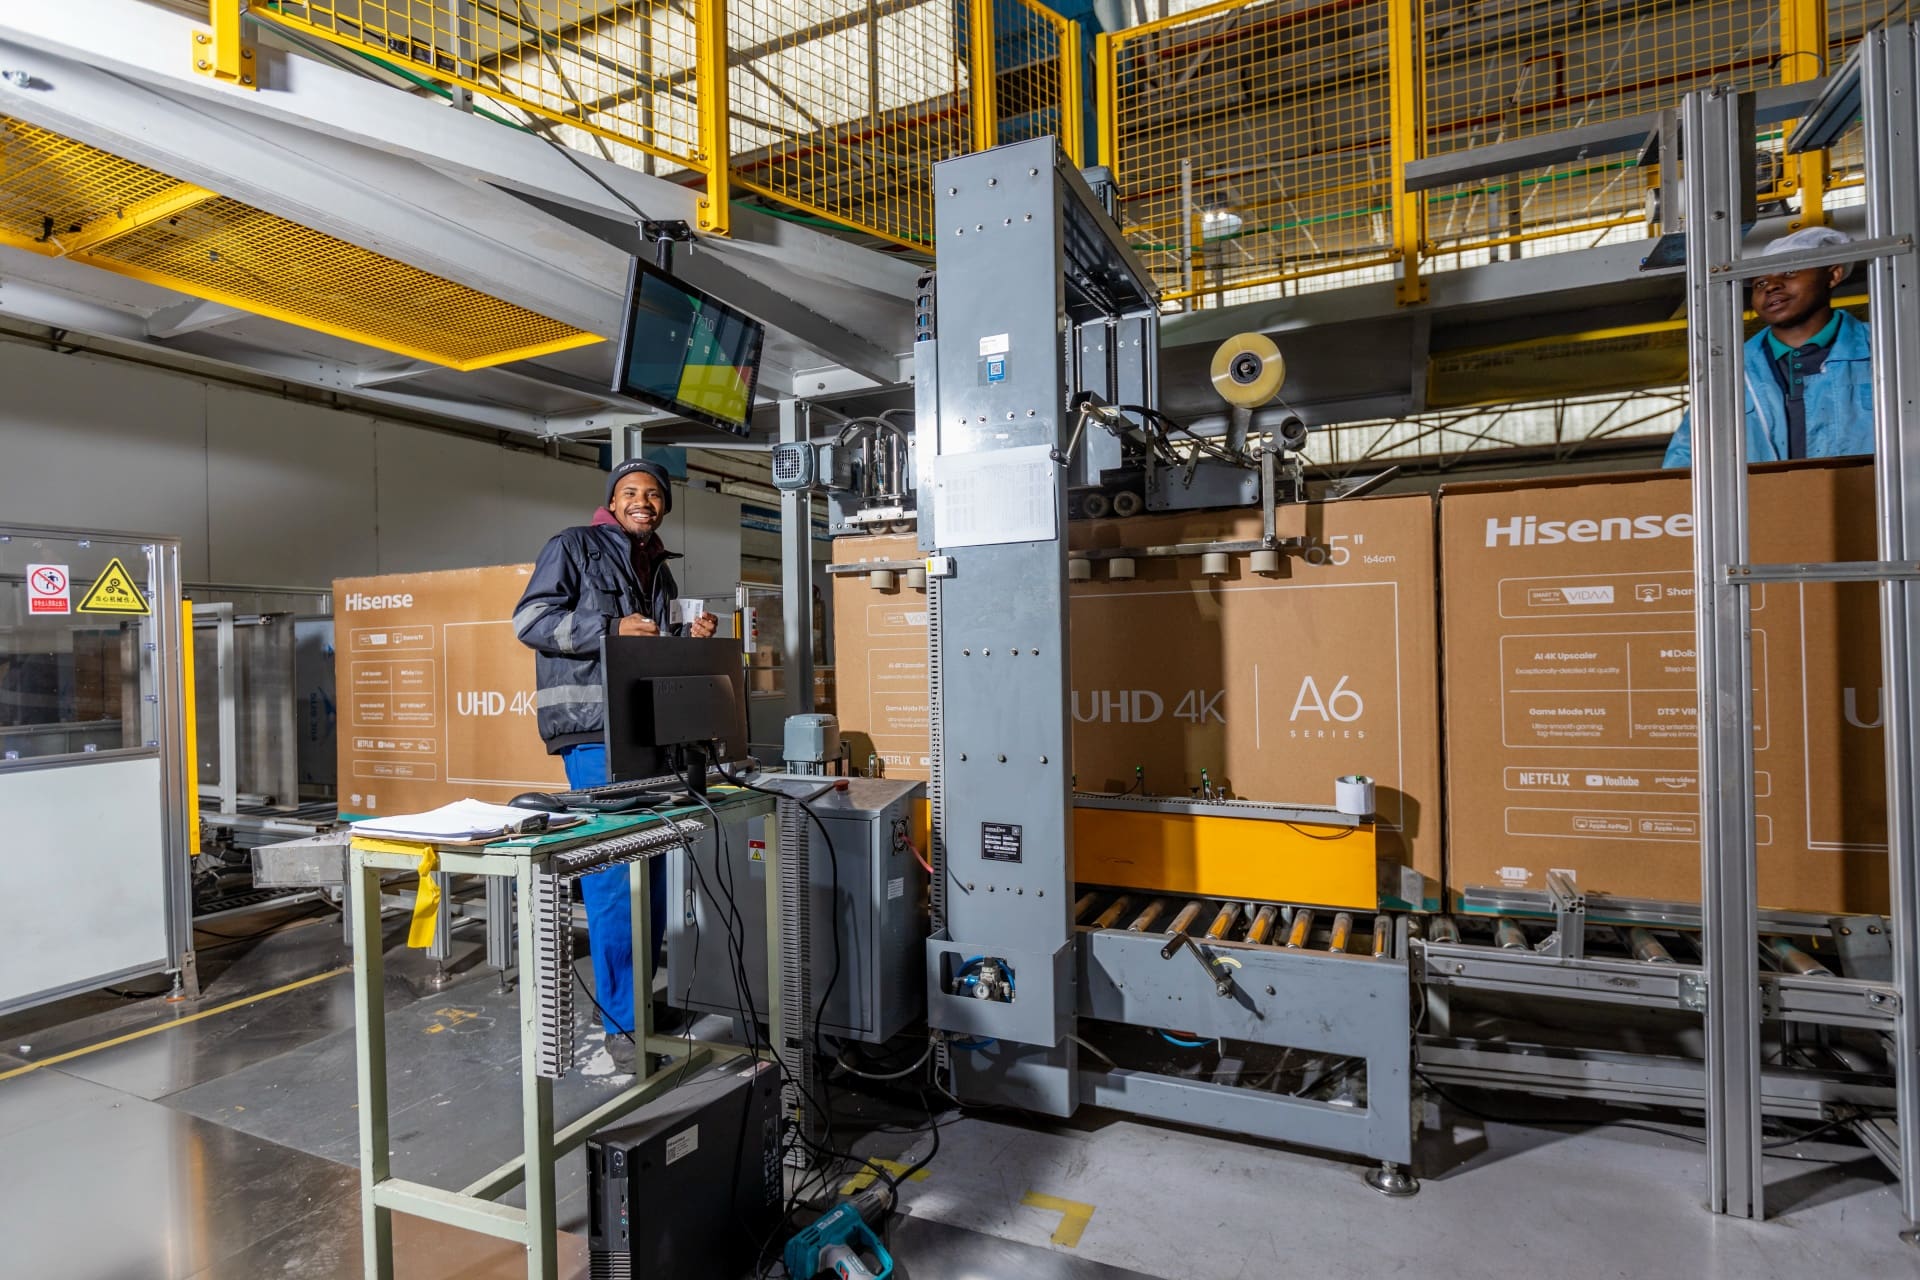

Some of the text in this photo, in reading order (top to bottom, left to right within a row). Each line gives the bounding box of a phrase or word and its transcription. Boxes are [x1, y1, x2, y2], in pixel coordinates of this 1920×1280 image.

[1485, 513, 1695, 547] Hisense
[1363, 555, 1396, 564] 164cm
[1666, 587, 1695, 596] Shar
[345, 593, 413, 611] Hisense
[1557, 652, 1597, 662] Upscaler
[457, 690, 537, 716] UHD 4K
[1289, 675, 1363, 722] A6
[1072, 688, 1226, 724] UHD 4K
[1529, 708, 1606, 716] Game Mode PLUS
[1289, 729, 1365, 739] SERIES
[1519, 772, 1570, 786] NETFLIX
[1604, 775, 1640, 787] YouTube
